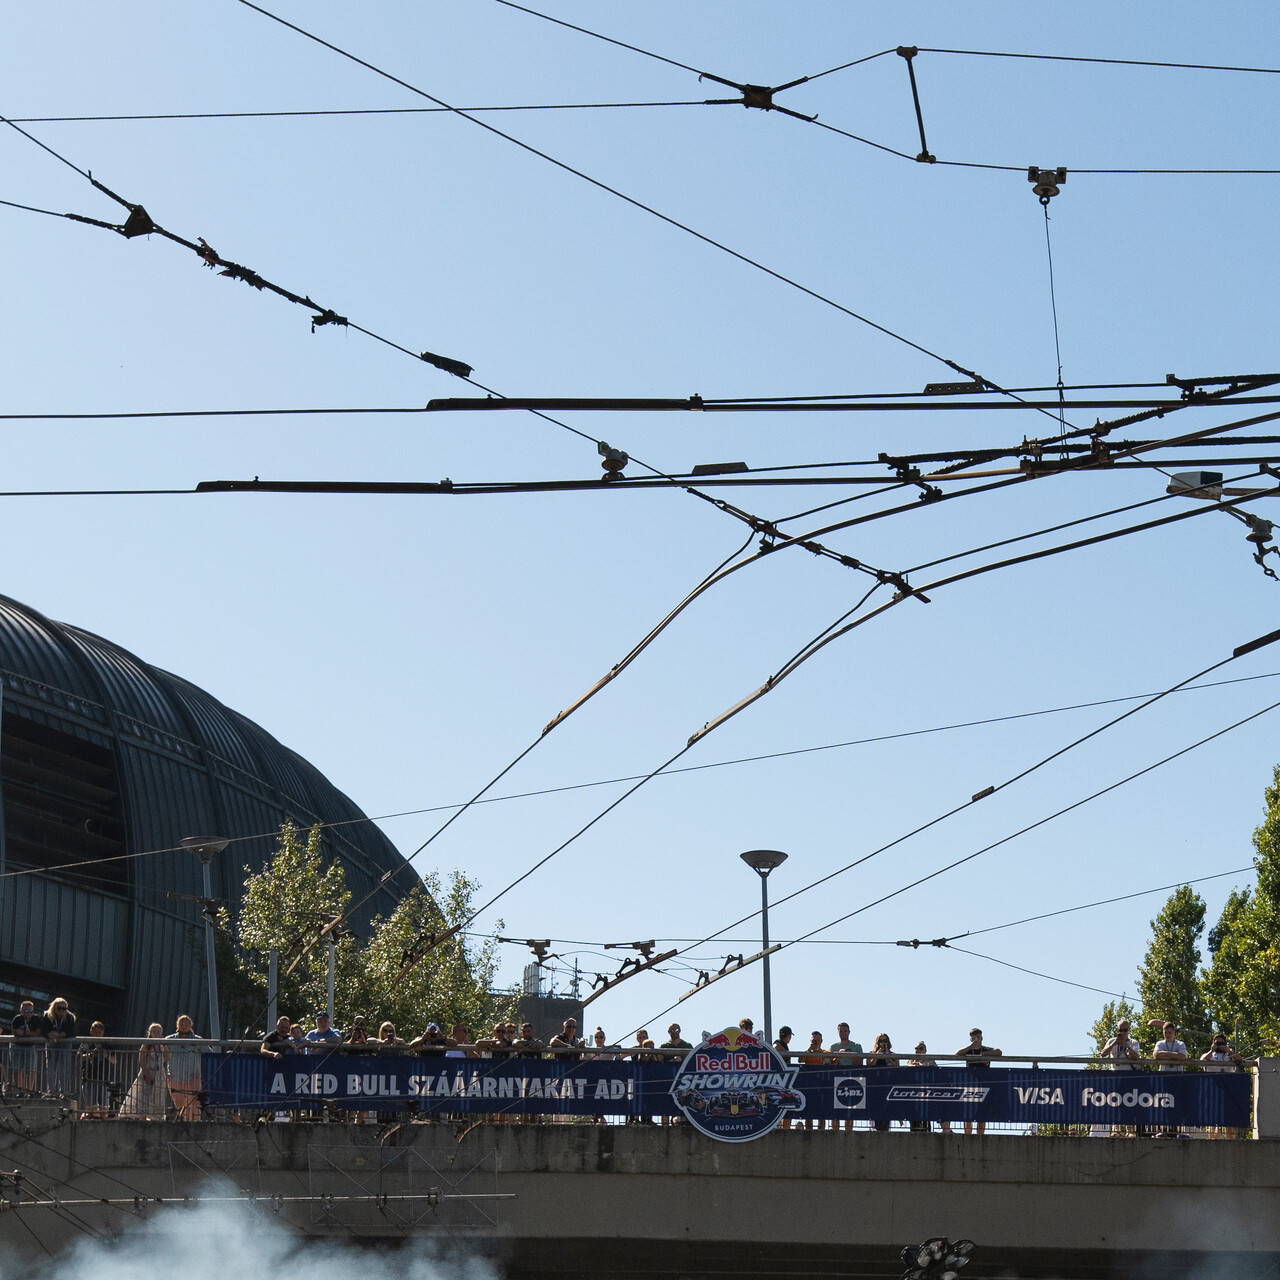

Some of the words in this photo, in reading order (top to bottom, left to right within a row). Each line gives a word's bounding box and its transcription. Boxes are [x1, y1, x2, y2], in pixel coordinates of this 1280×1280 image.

[696, 1053, 733, 1071] Red
[736, 1052, 770, 1071] Bull
[270, 1073, 286, 1094] A
[295, 1073, 338, 1095] RED
[347, 1074, 400, 1096] BULL
[408, 1070, 587, 1098] SZÁÁÁRNYAKAT
[594, 1078, 634, 1100] AD!
[678, 1073, 790, 1090] SHOWRUN
[1013, 1086, 1064, 1105] VISA
[1082, 1088, 1174, 1107] foodora
